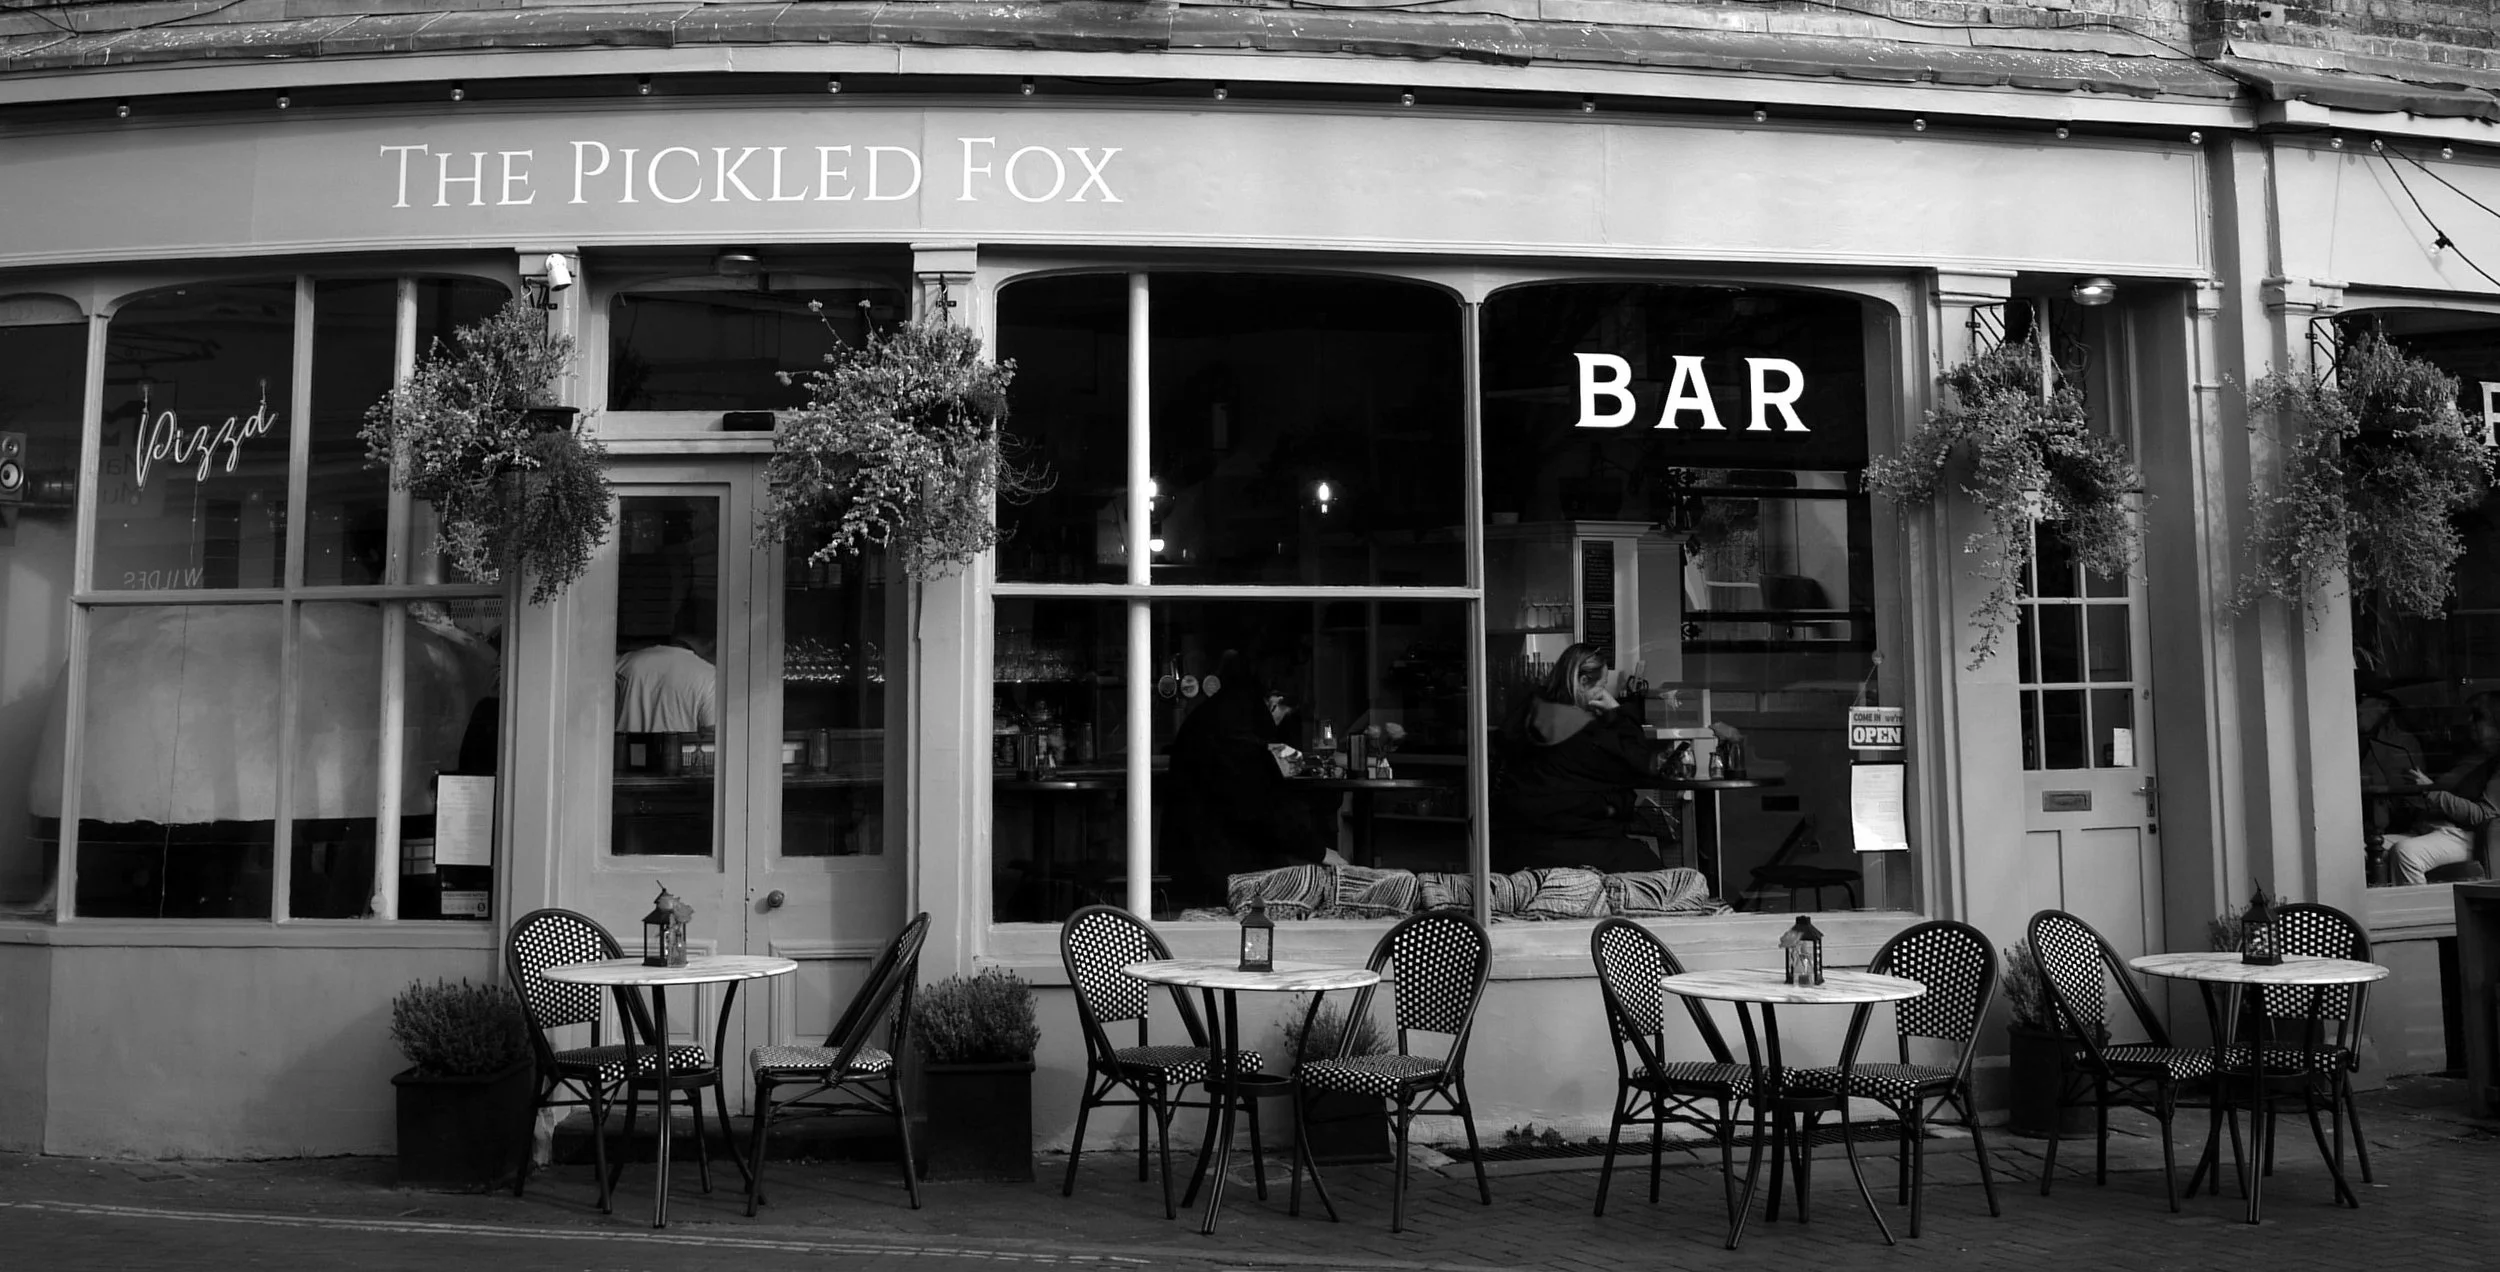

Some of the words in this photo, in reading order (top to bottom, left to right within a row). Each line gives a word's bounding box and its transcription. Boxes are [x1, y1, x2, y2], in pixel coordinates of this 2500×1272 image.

[379, 143, 537, 208] THE
[568, 140, 923, 205] PICKLED
[956, 135, 1124, 203] FOX
[1573, 351, 1811, 432] BAR
[136, 405, 279, 488] Pizza
[1853, 713, 1873, 722] COME
[1874, 713, 1882, 722] IN
[1853, 727, 1902, 744] OPEN
